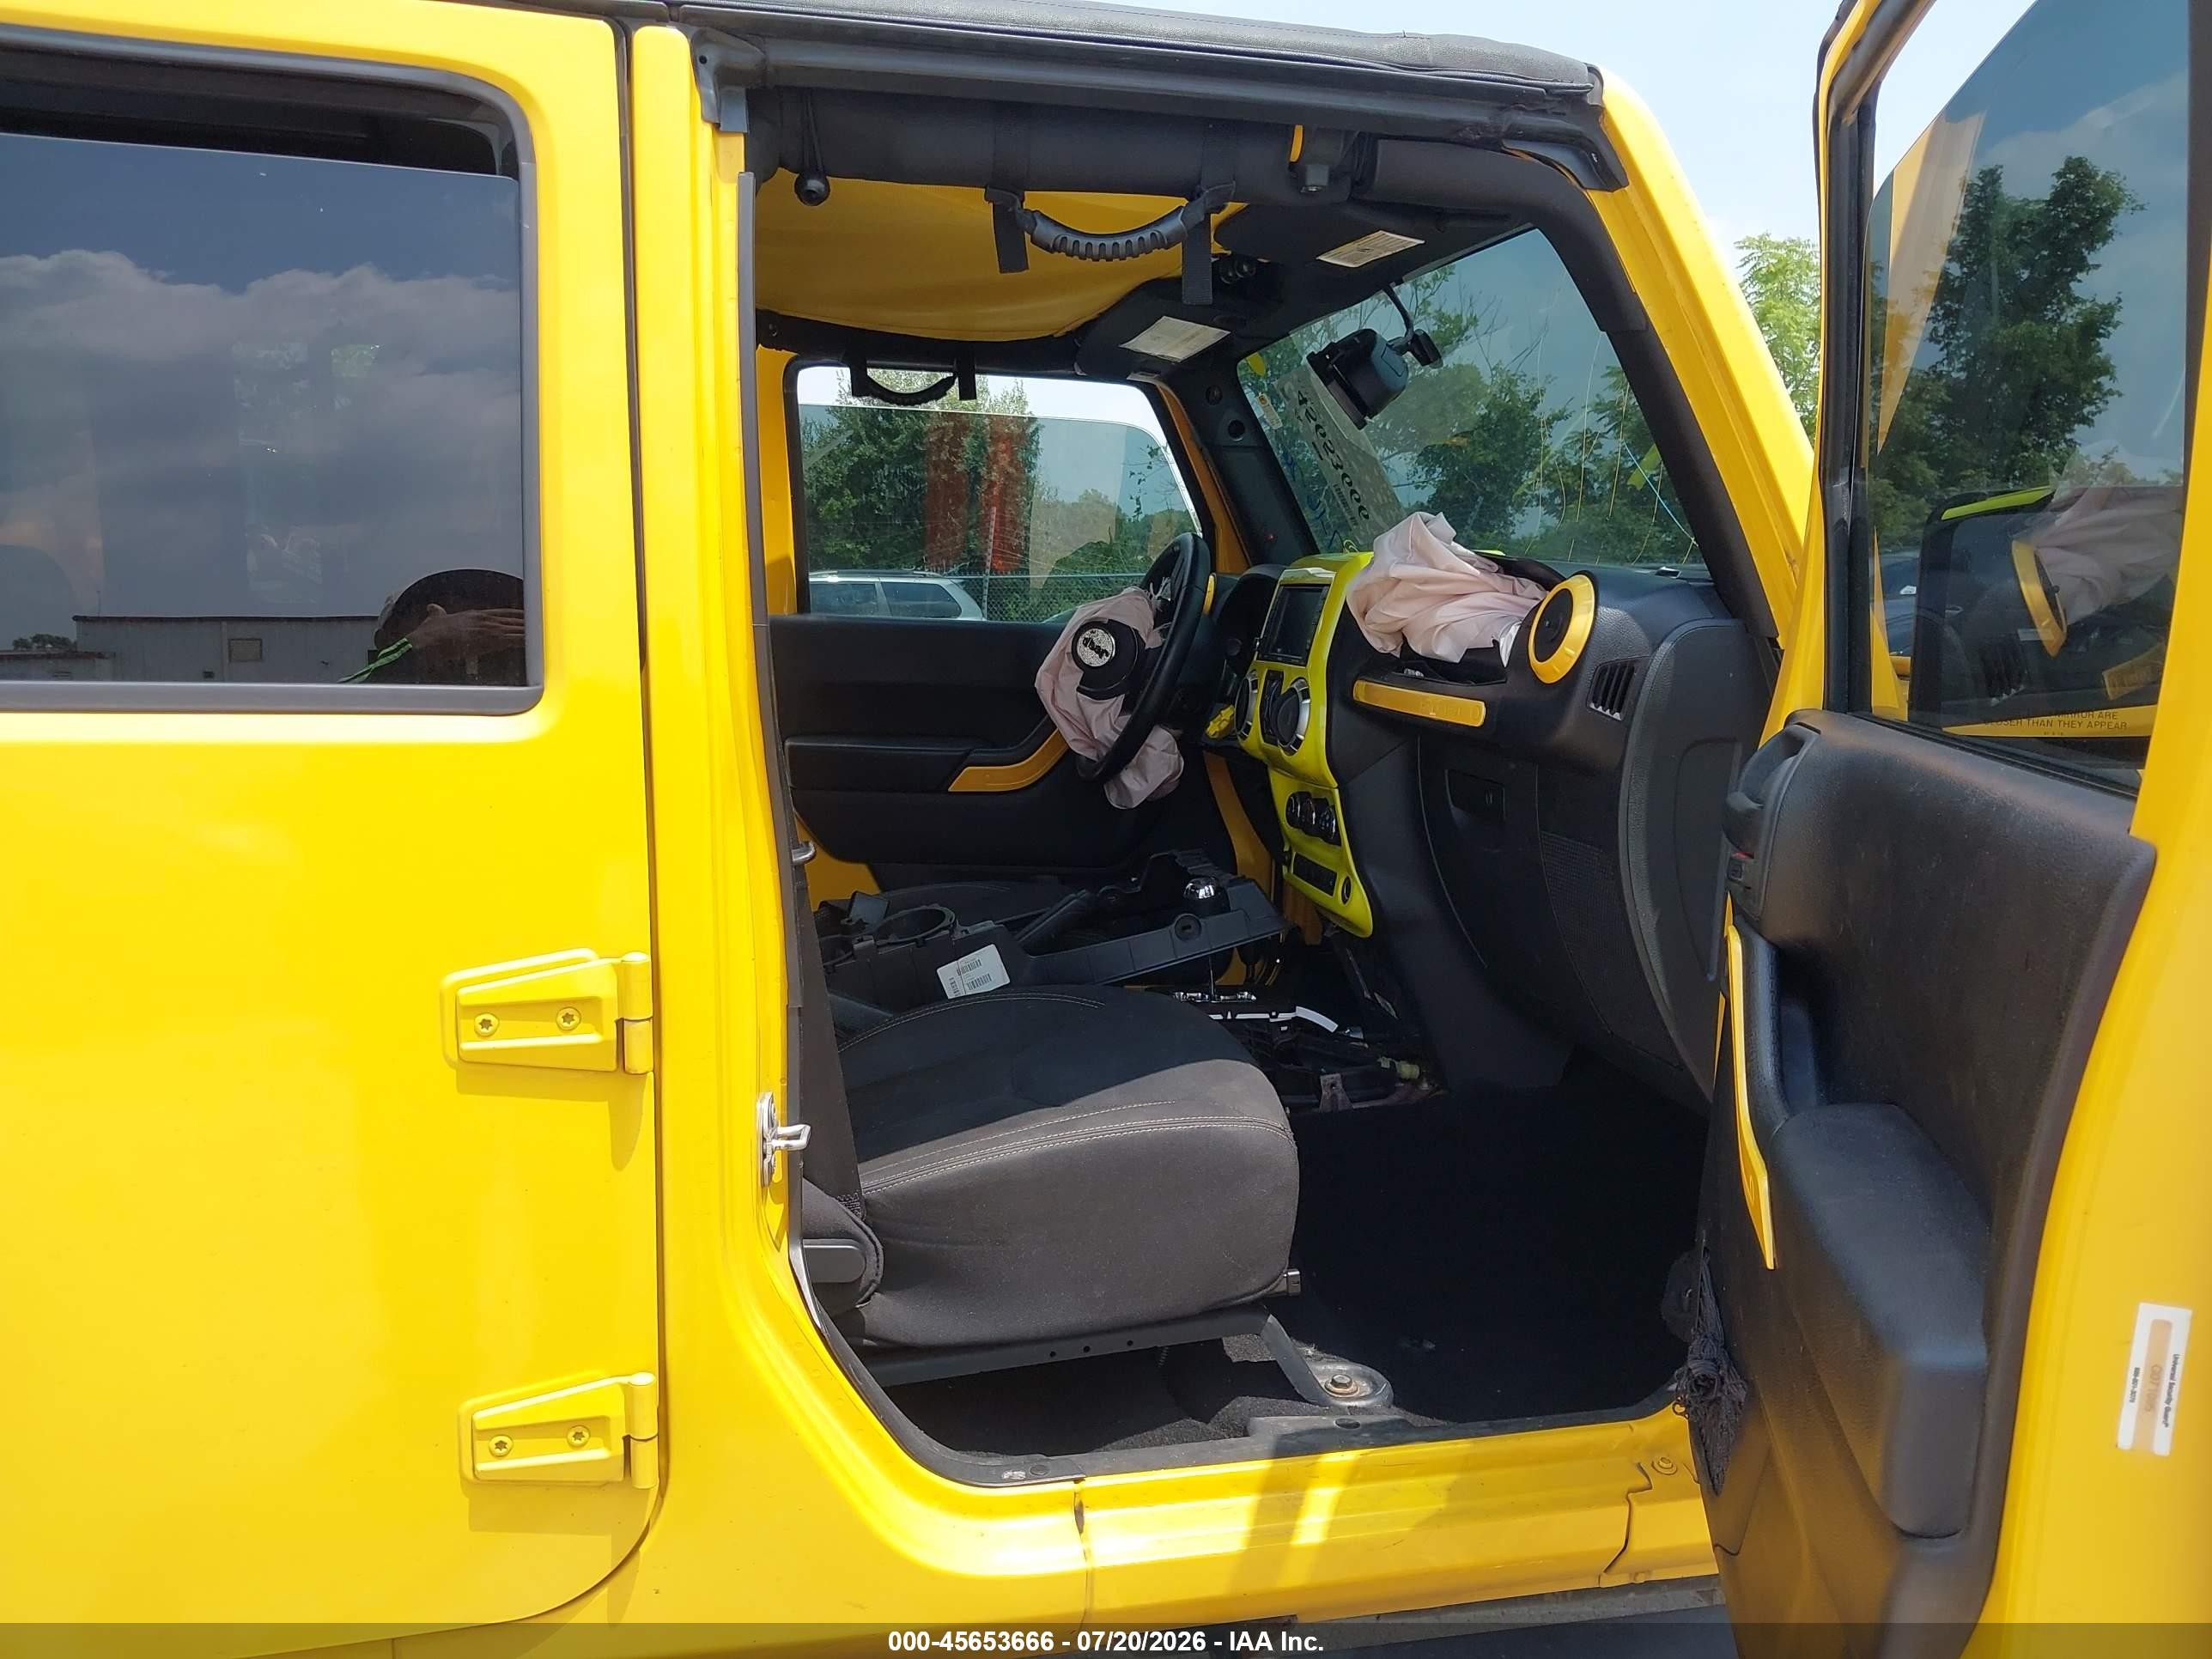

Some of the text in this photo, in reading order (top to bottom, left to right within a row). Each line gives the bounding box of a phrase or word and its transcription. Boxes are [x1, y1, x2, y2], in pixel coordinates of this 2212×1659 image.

[1083, 637, 1109, 659] Jeep
[2098, 711, 2118, 720] ARE
[2027, 719, 2054, 728] THAN
[2058, 720, 2083, 729] THEY
